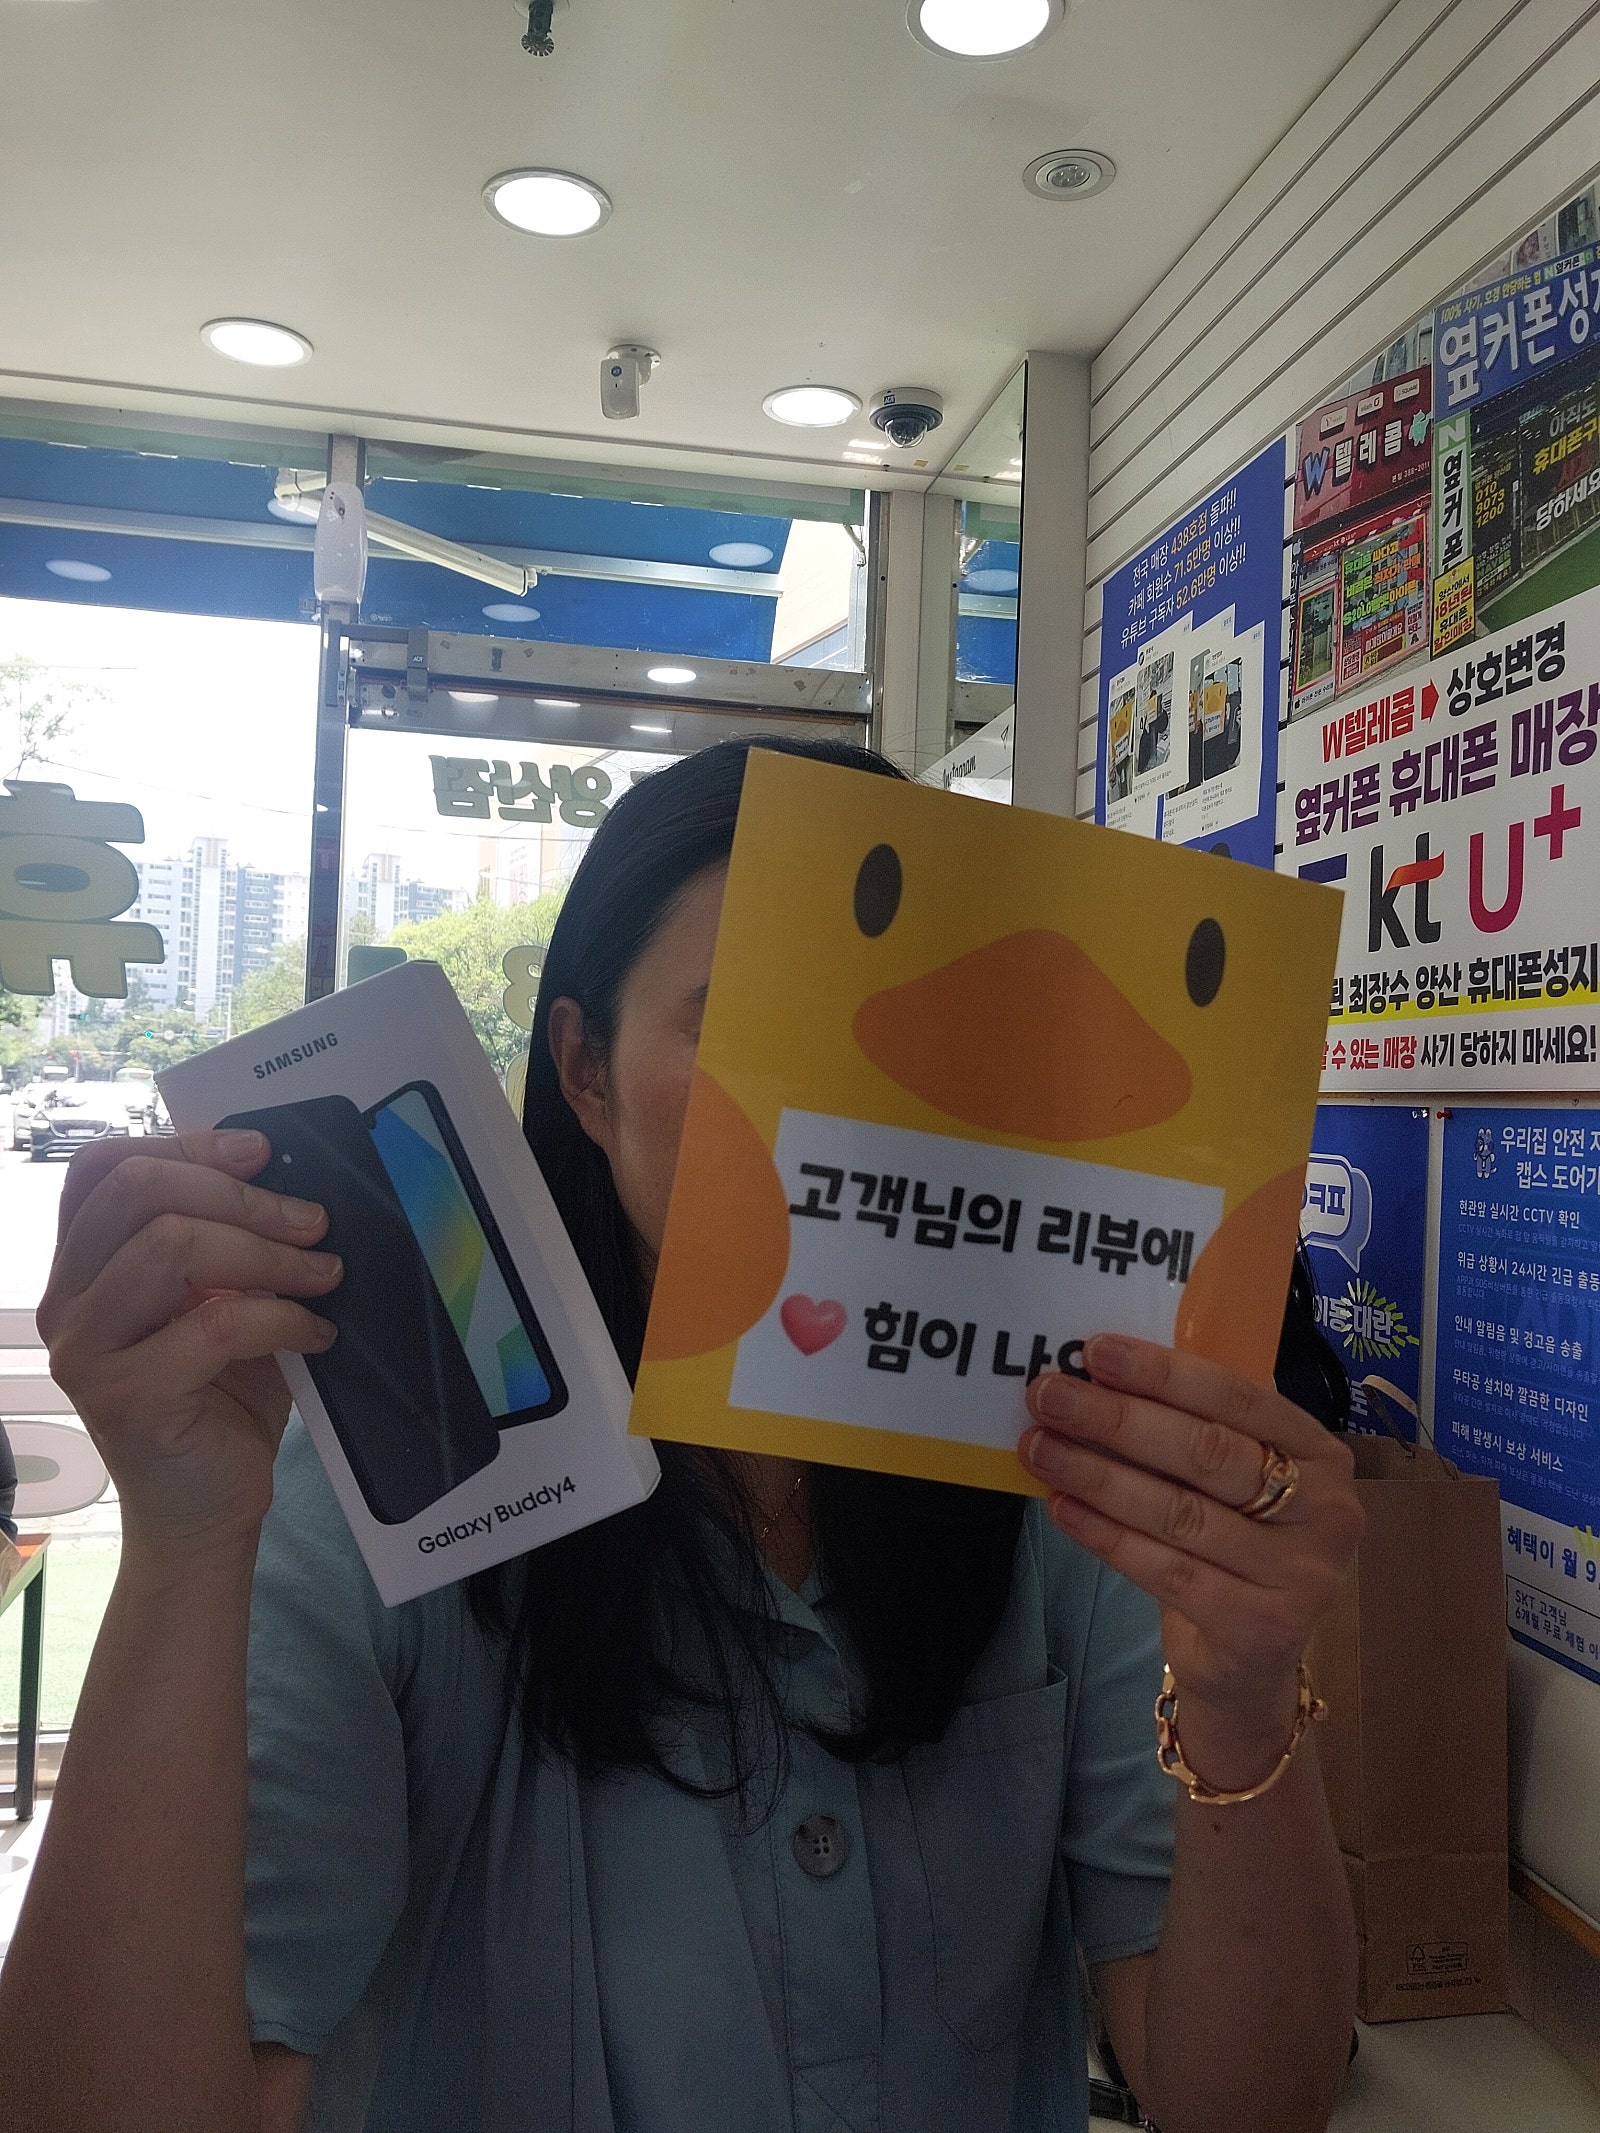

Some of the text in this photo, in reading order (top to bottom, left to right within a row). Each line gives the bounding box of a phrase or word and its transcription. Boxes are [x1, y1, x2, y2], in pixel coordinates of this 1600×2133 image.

[1533, 416, 1600, 475] 휴대폰구
[1442, 450, 1463, 574] 옆커폰
[1475, 481, 1497, 503] 010
[1475, 488, 1505, 515] 8073
[1476, 502, 1505, 528] 1200
[1536, 467, 1600, 531] 당하세요
[1133, 488, 1237, 588] 전국 매장 438호점 돌파!!
[1128, 515, 1241, 616] 카페 회원수 71.5만명 이상!!
[1121, 542, 1247, 649] 유튜브 구독자 52.6만명 이상!!
[1322, 621, 1566, 763] W텔레콤 상호변경
[1295, 682, 1600, 846] 옆커폰 휴대폰 매장
[1368, 832, 1445, 953] kt
[1349, 969, 1410, 1014] 최장수
[1416, 962, 1462, 1010] 양산
[1467, 943, 1599, 1004] 휴대폰성지
[253, 1032, 338, 1079] SAMSUNG
[1331, 1040, 1346, 1070] 수
[1350, 1038, 1379, 1070] 있는
[1383, 1035, 1417, 1070] 매장
[1421, 1033, 1455, 1067] 사기
[1460, 1029, 1517, 1067] 당하지
[1523, 1024, 1597, 1064] 마세요!
[1500, 1126, 1547, 1156] 우리집
[1553, 1128, 1585, 1158] 안전
[1516, 1161, 1548, 1189] 캡스
[789, 1162, 1195, 1283] 고객님의 리뷰에
[1459, 1199, 1580, 1229] 현관앞 실시간 CCTV 확인
[1458, 1251, 1600, 1292] 위급 상황시 24시간 긴급 출동
[864, 1301, 977, 1377] 힘이
[1455, 1315, 1583, 1361] 안내 알림음 및 경고음 송출
[1453, 1368, 1588, 1423] 무타공 설치와 깔끔한 디자인
[1452, 1421, 1564, 1472] 피해 발생시 보상 서비스
[418, 1476, 576, 1553] Galaxy Buddy4
[1507, 1525, 1554, 1569] 혜택이
[1561, 1547, 1577, 1579] 월
[1515, 1589, 1567, 1627] SKT 고객님
[1515, 1607, 1540, 1631] 6개월
[1543, 1621, 1562, 1641] 무료
[1565, 1631, 1585, 1654] 체험
